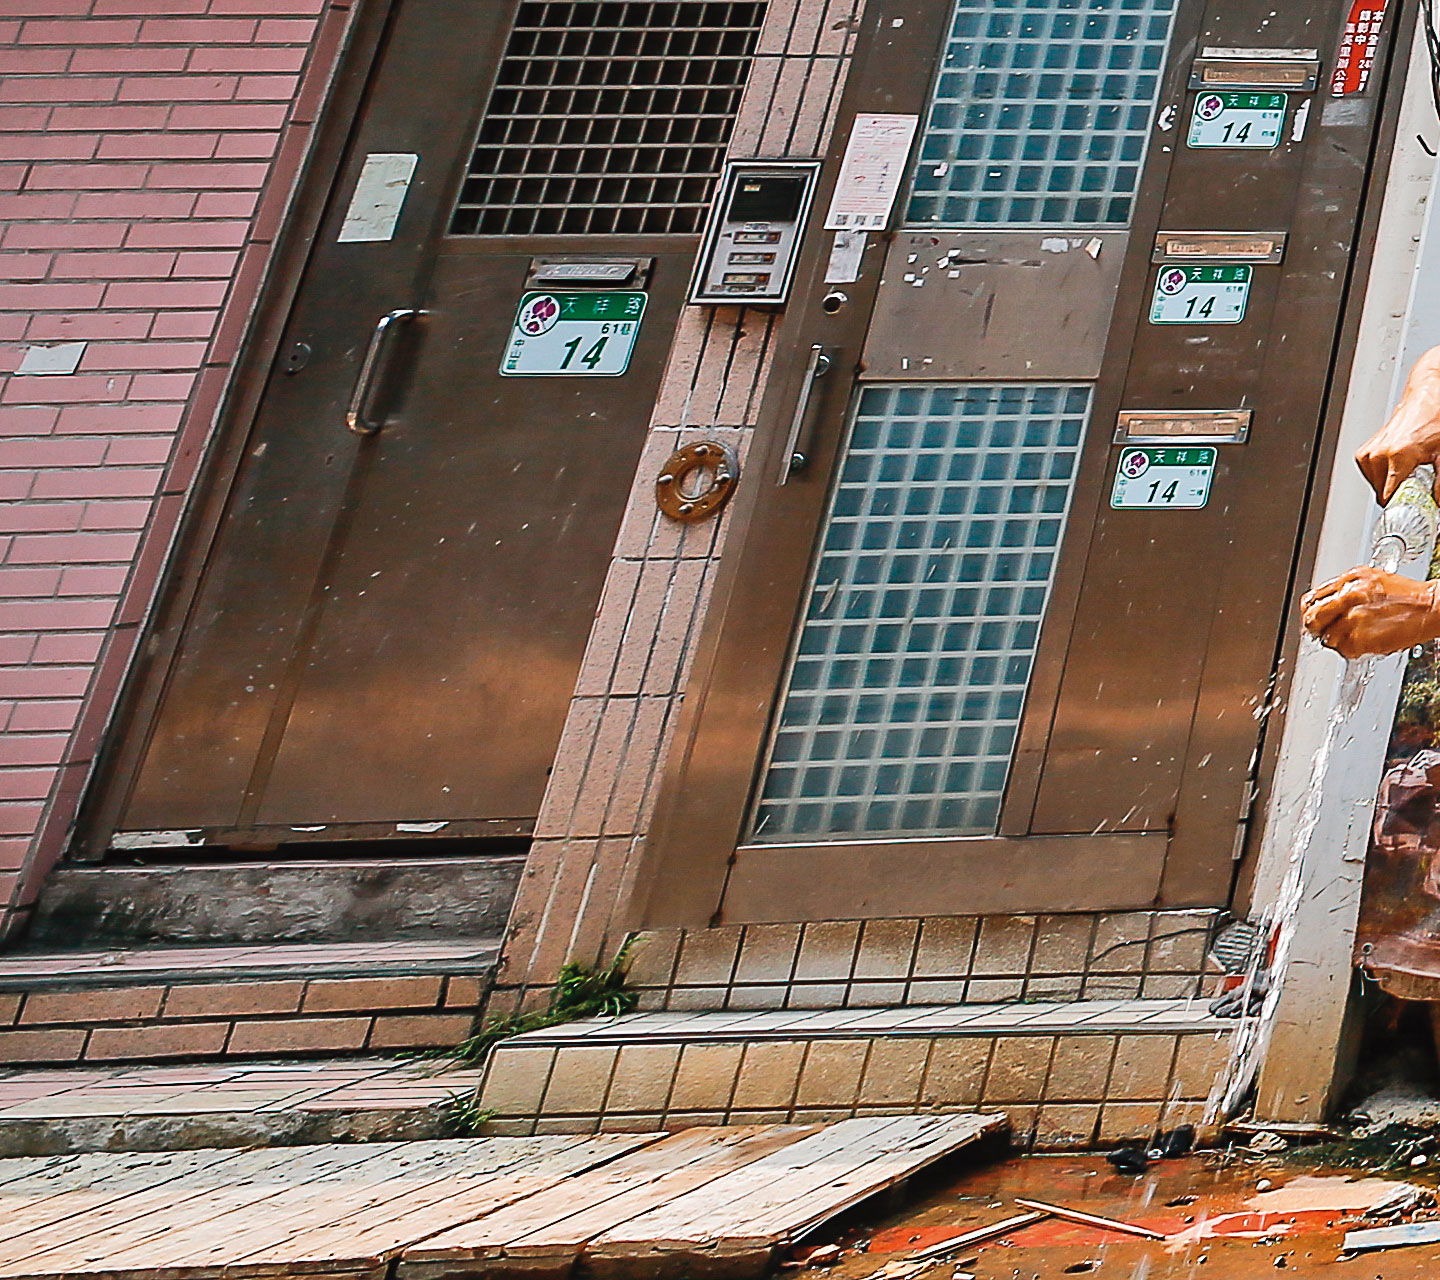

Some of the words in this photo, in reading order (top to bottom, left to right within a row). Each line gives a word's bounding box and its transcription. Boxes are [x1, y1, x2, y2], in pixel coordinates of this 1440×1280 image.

[1228, 94, 1280, 107] 天祥路
[1222, 122, 1253, 143] 14
[1191, 267, 1245, 280] 天祥路
[561, 296, 642, 315] 天祥路
[1184, 296, 1216, 318] 14
[601, 322, 632, 335] 61巷
[560, 336, 610, 370] 14
[1154, 450, 1209, 463] 天祥路
[1147, 480, 1179, 503] 14
